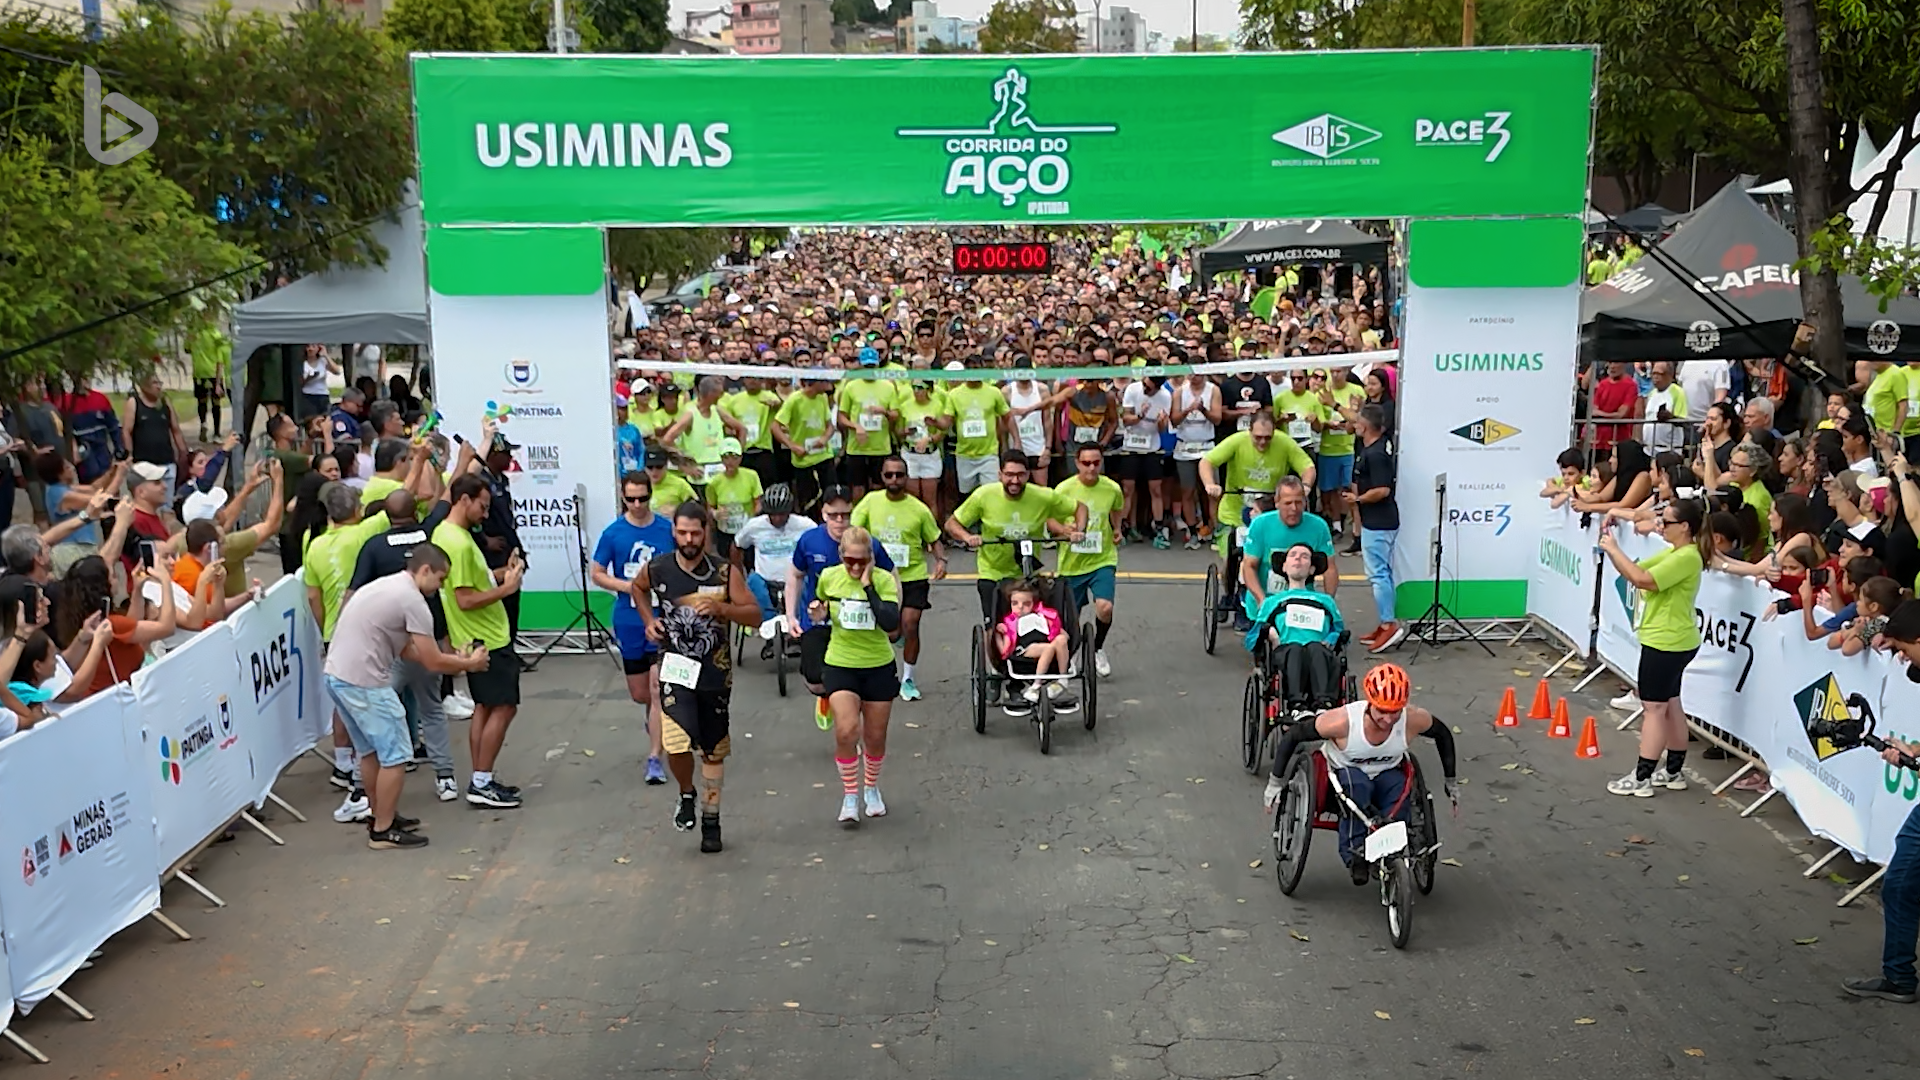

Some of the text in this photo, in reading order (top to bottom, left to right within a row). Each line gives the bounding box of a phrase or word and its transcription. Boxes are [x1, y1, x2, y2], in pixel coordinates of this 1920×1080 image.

[946, 137, 1068, 153] CORRIDA DO
[1305, 124, 1351, 147] IBIS
[475, 122, 733, 169] USIMINAS
[945, 154, 1070, 207] AÇO
[957, 246, 1047, 269] 0:00:00
[1435, 353, 1544, 372] USIMINAS
[1470, 424, 1501, 440] IBIS
[527, 445, 560, 460] MINAS
[513, 499, 573, 512] MINAS
[514, 514, 579, 527] GERAIS
[1024, 543, 1030, 553] 1
[1540, 536, 1582, 586] USIMINAS
[842, 611, 869, 624] 5891
[73, 800, 106, 834] MINAS
[76, 818, 113, 854] GERAIS
